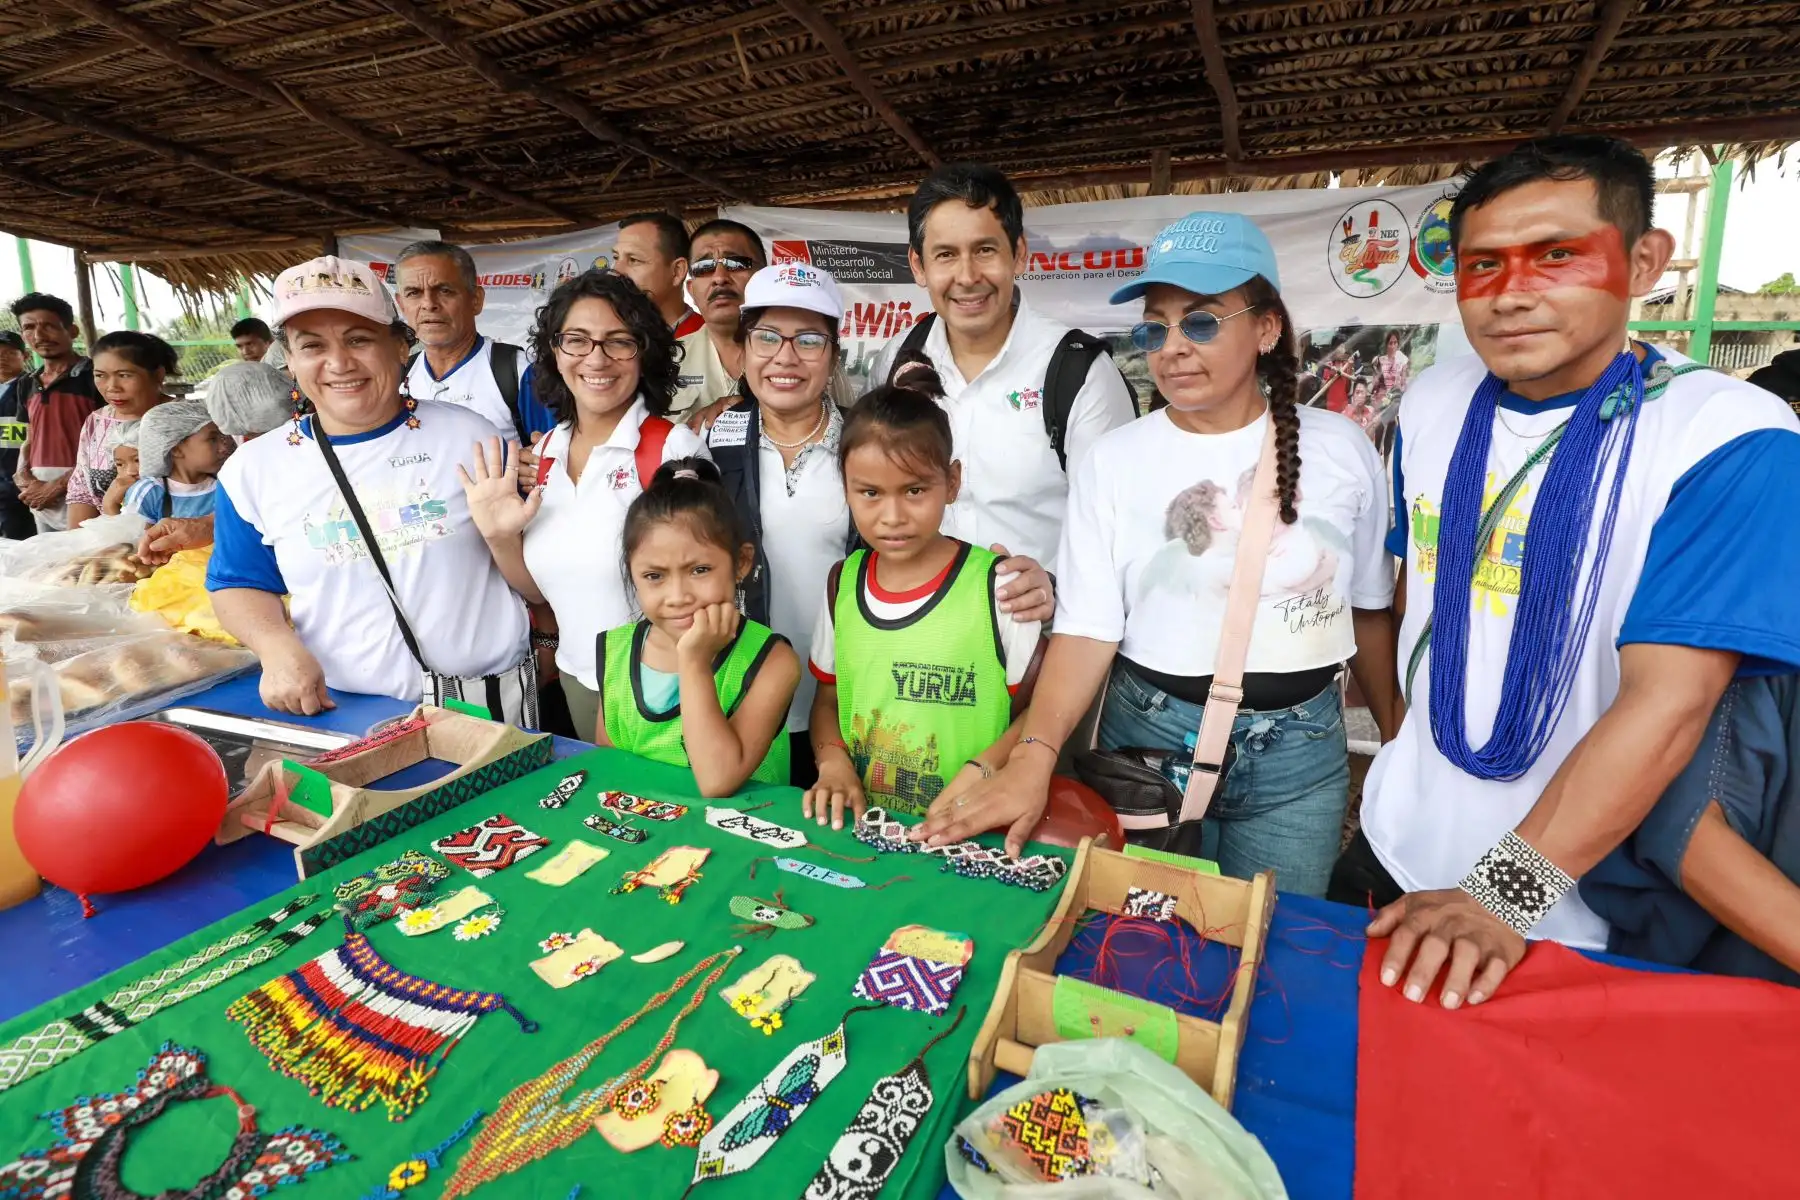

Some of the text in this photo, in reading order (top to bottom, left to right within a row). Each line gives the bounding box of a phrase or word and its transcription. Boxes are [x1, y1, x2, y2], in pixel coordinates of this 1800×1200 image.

[1380, 229, 1399, 239] NEC
[812, 246, 858, 255] Ministerio
[816, 257, 875, 267] de Desarrollo
[829, 268, 893, 279] nclusión Social
[1022, 271, 1080, 281] Cooperación
[1083, 272, 1104, 280] para
[1106, 270, 1115, 278] el
[1118, 269, 1145, 278] Desar
[476, 273, 532, 287] NCODES
[0, 426, 27, 441] EN
[1273, 588, 1333, 622] Totally
